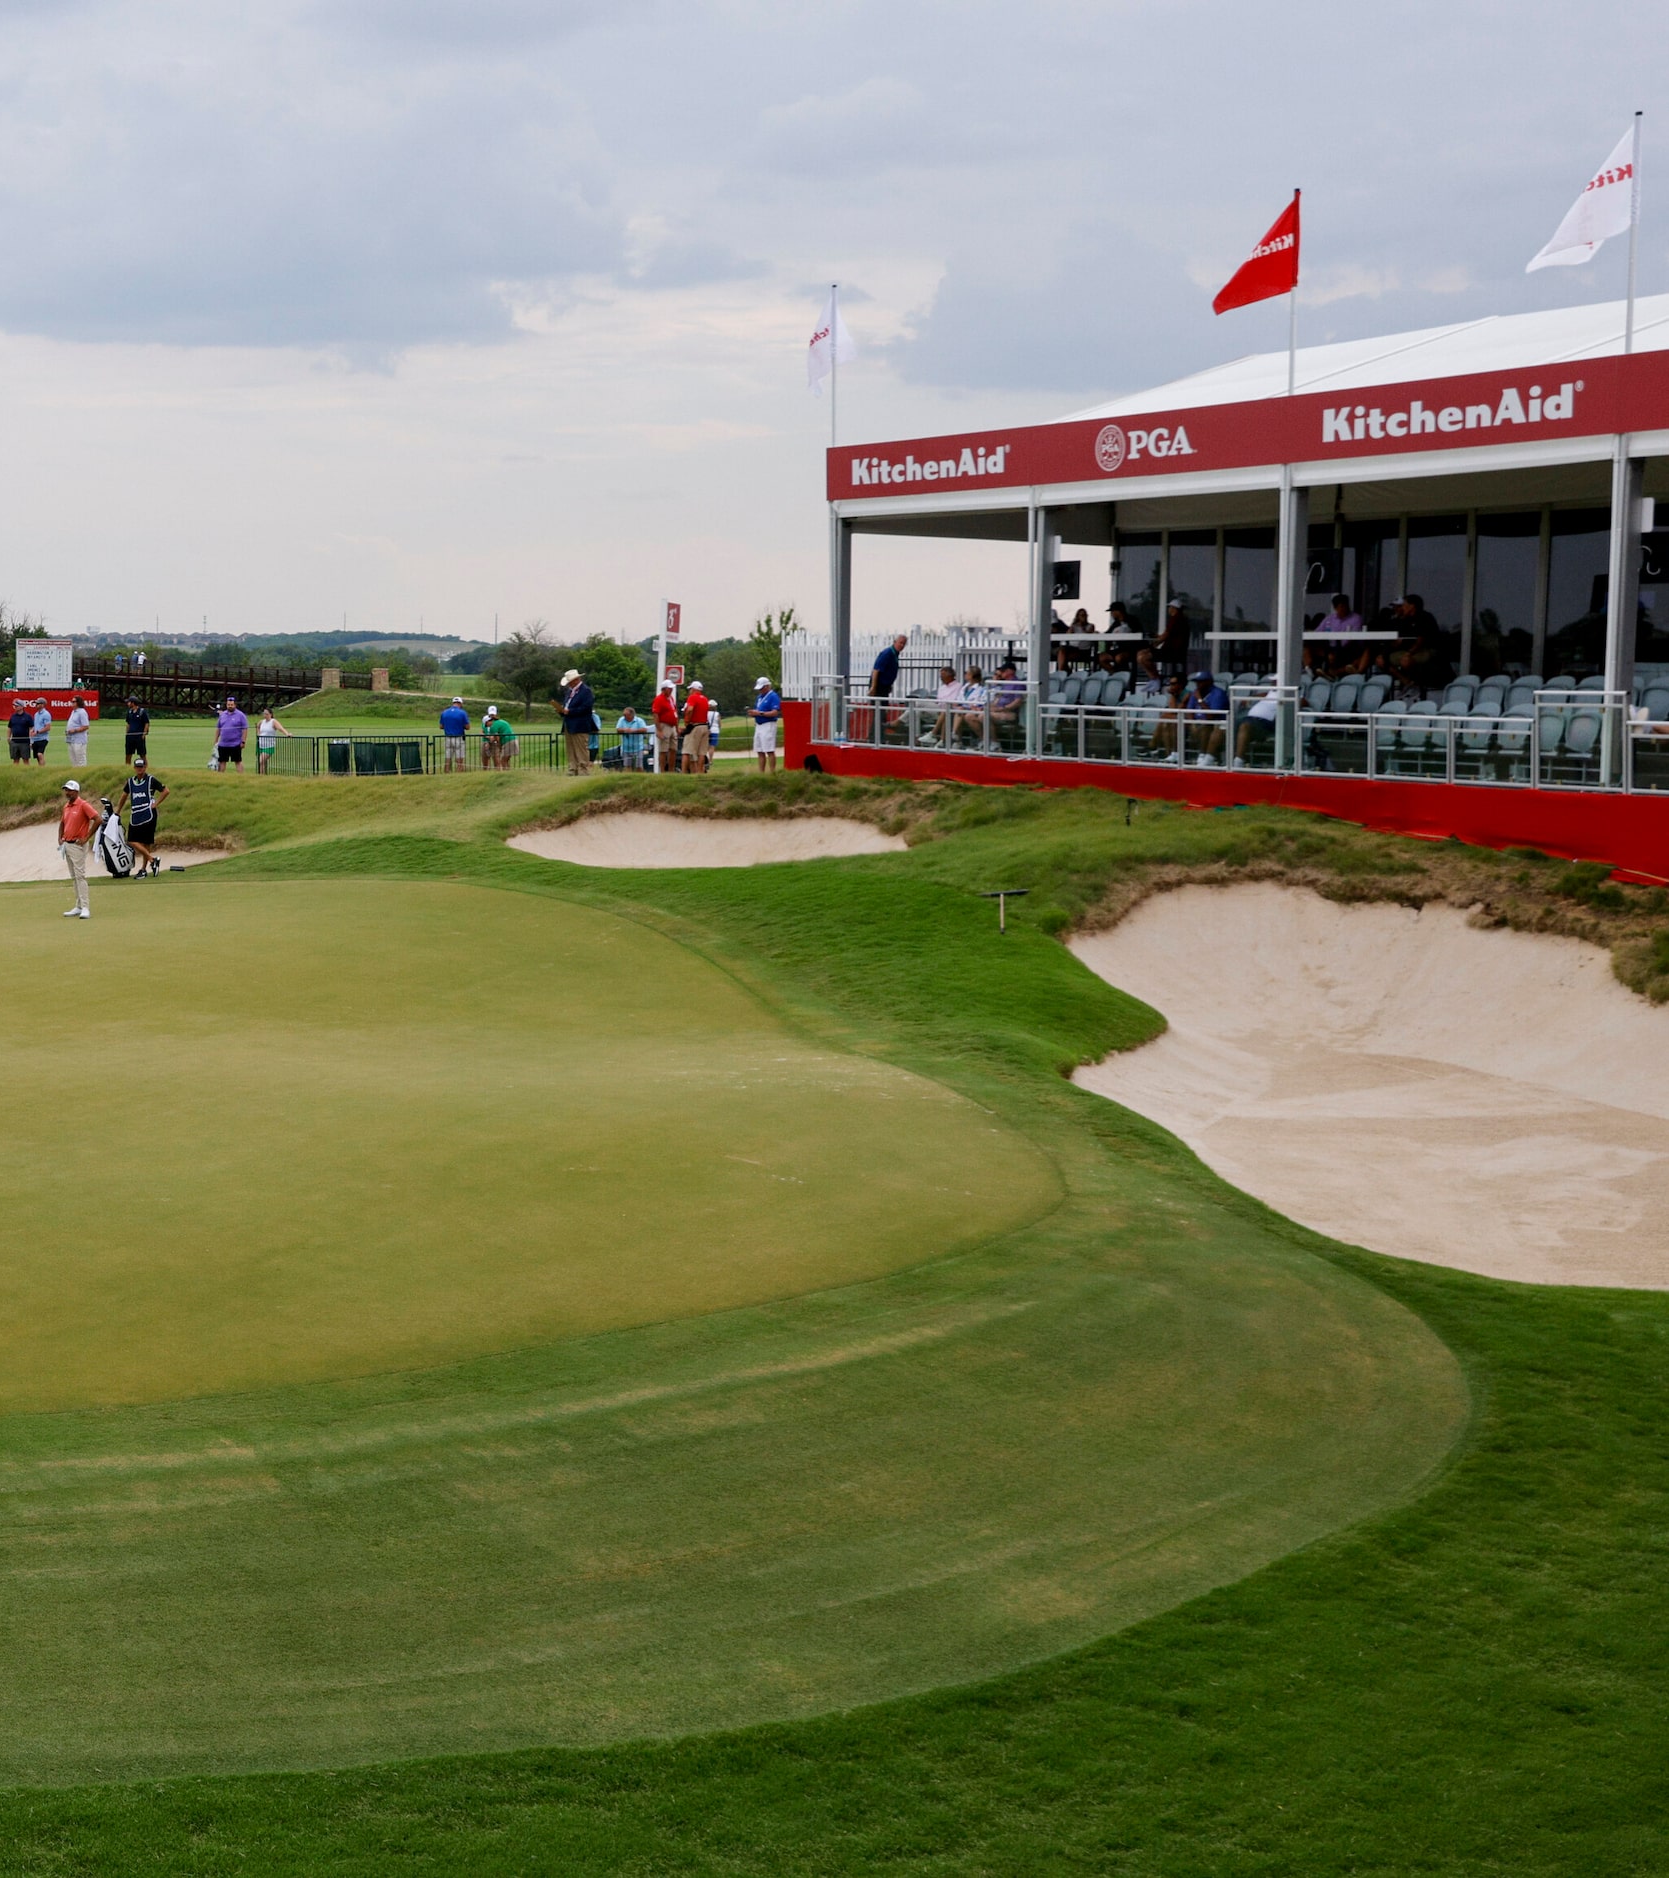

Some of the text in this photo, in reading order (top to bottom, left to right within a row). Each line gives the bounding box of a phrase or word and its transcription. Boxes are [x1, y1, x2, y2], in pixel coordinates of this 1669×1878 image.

[1321, 382, 1575, 443] KitchenAid
[1127, 425, 1194, 460] PGA
[851, 444, 1005, 486] KitchenAid
